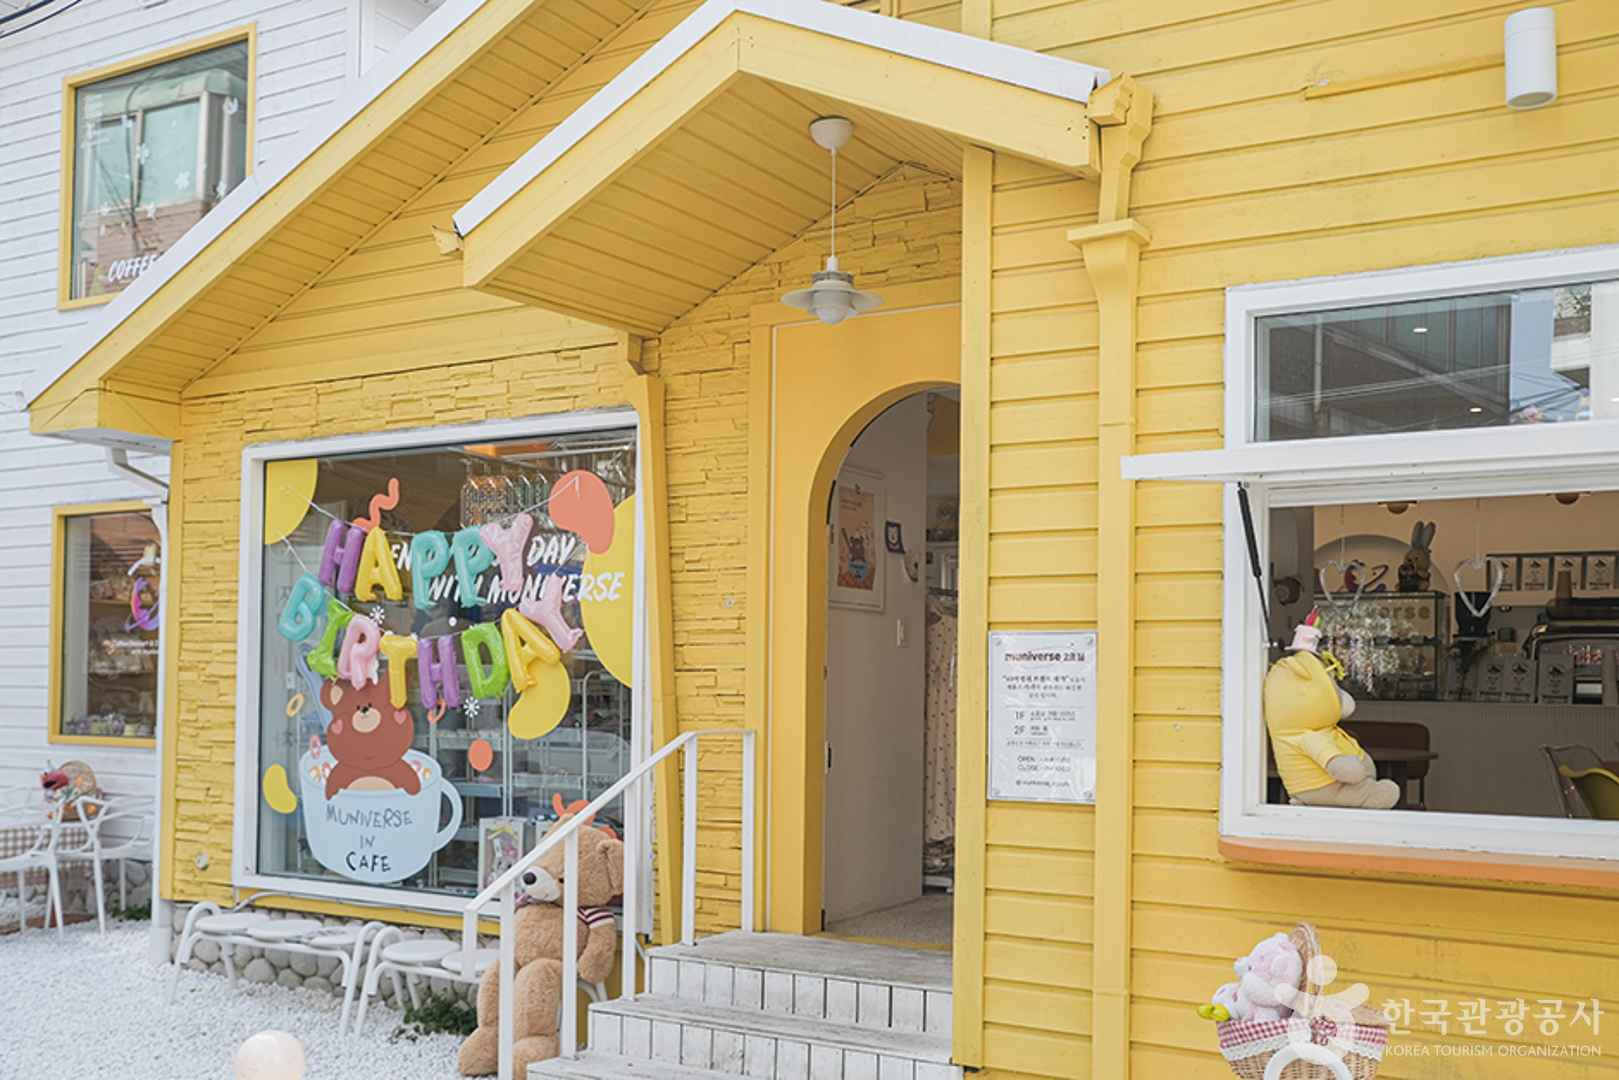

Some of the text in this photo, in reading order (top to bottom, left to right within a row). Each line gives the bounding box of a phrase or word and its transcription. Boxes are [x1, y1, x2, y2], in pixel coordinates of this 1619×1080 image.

[108, 254, 160, 282] COFFE
[319, 512, 533, 611] HAPPY
[527, 535, 576, 566] DAY
[278, 572, 585, 709] BIRTHDAY
[1004, 650, 1061, 662] muniverse
[325, 803, 414, 829] MUNIVERSE
[359, 834, 376, 849] IN
[345, 851, 393, 873] CAFE
